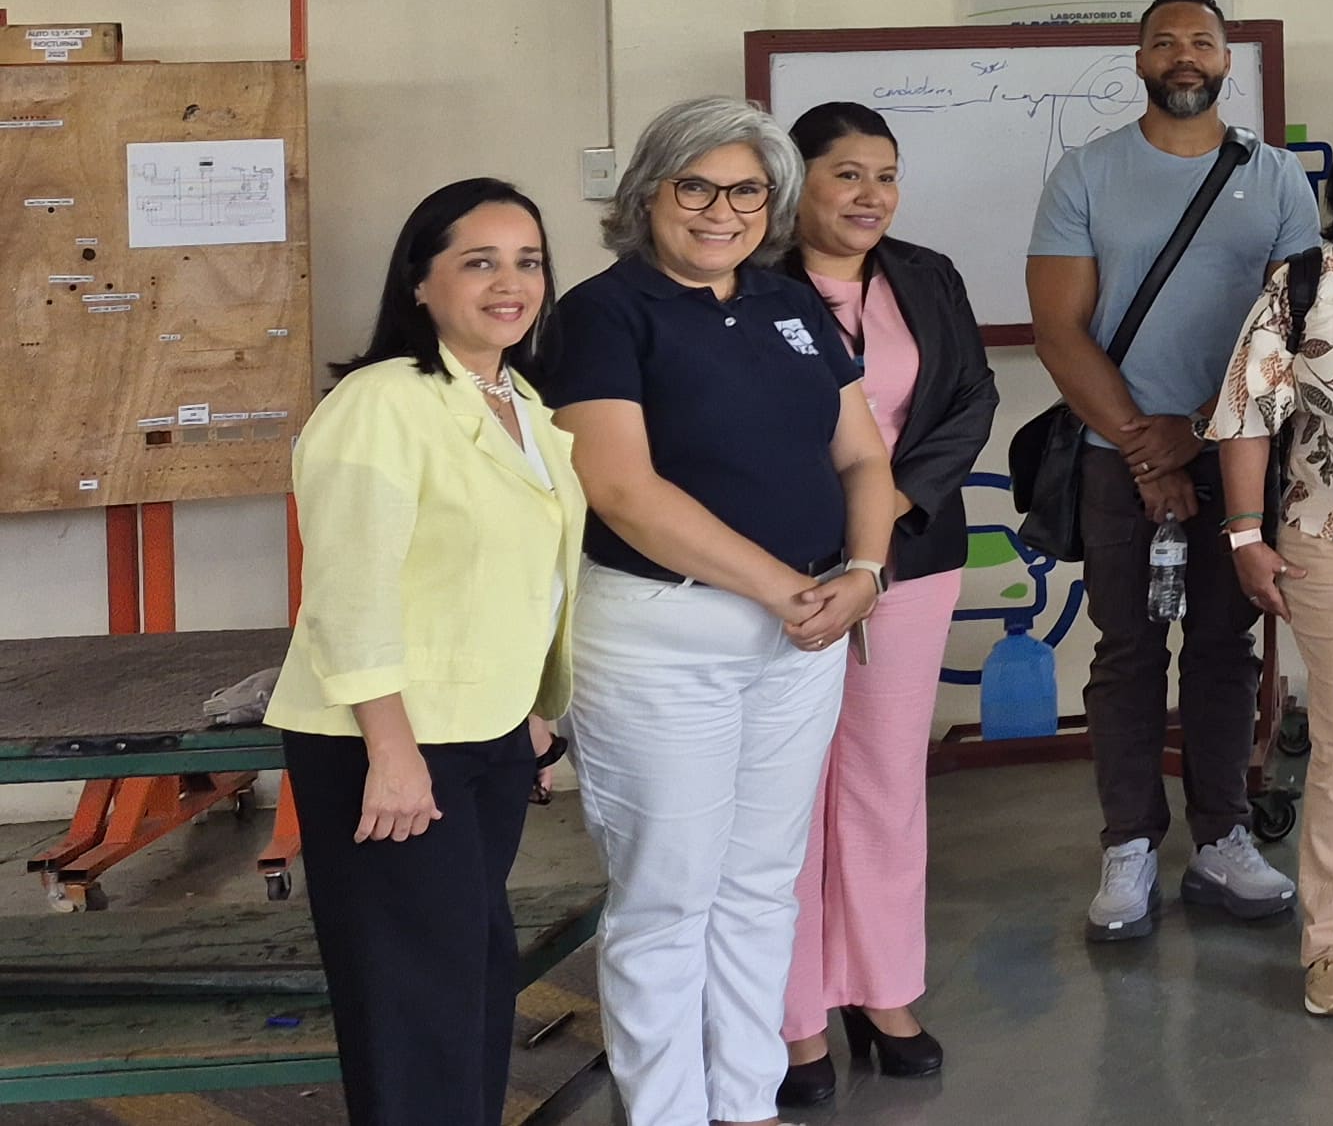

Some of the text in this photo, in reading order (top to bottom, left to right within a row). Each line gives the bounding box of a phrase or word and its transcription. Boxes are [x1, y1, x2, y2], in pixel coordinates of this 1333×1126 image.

[1050, 11, 1133, 21] LABORATORIO DE
[33, 40, 79, 48] NOCTURNA
